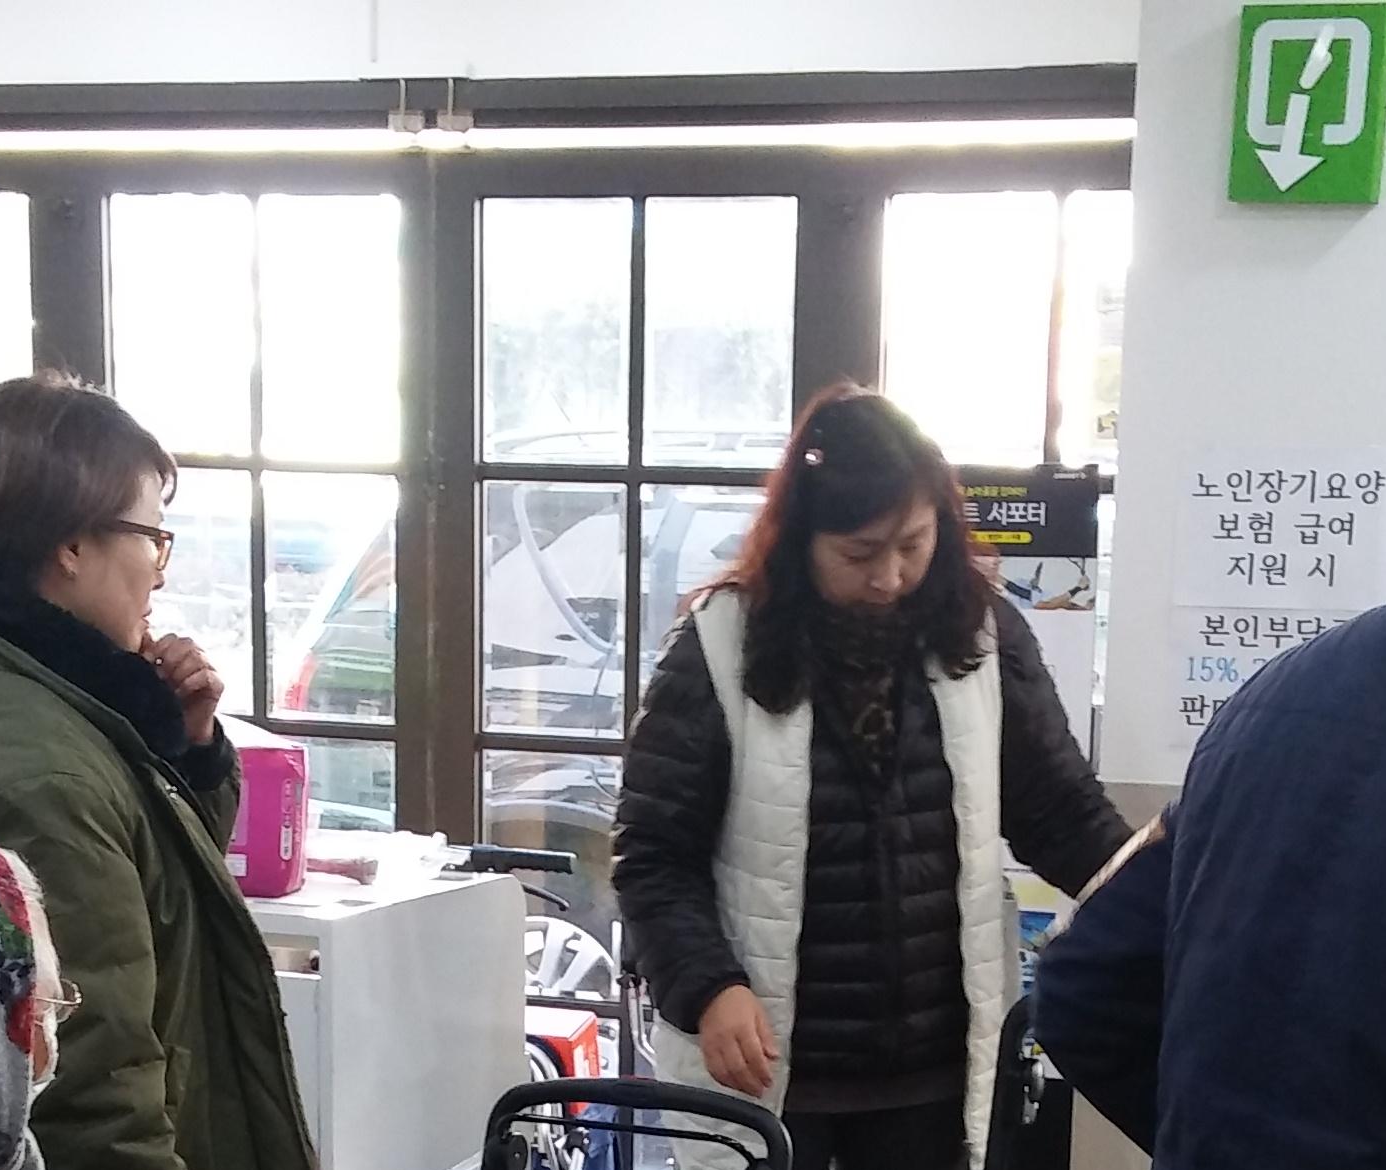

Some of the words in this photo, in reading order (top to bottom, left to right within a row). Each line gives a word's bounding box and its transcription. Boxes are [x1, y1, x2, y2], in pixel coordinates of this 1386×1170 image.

[1192, 470, 1386, 505] 노인장기요양
[987, 501, 1046, 526] 서포터
[1213, 512, 1274, 545] 보험
[1295, 513, 1356, 545] 급여
[1226, 554, 1287, 587] 지원
[1308, 555, 1336, 587] 시
[1199, 615, 1350, 649] 본인부담
